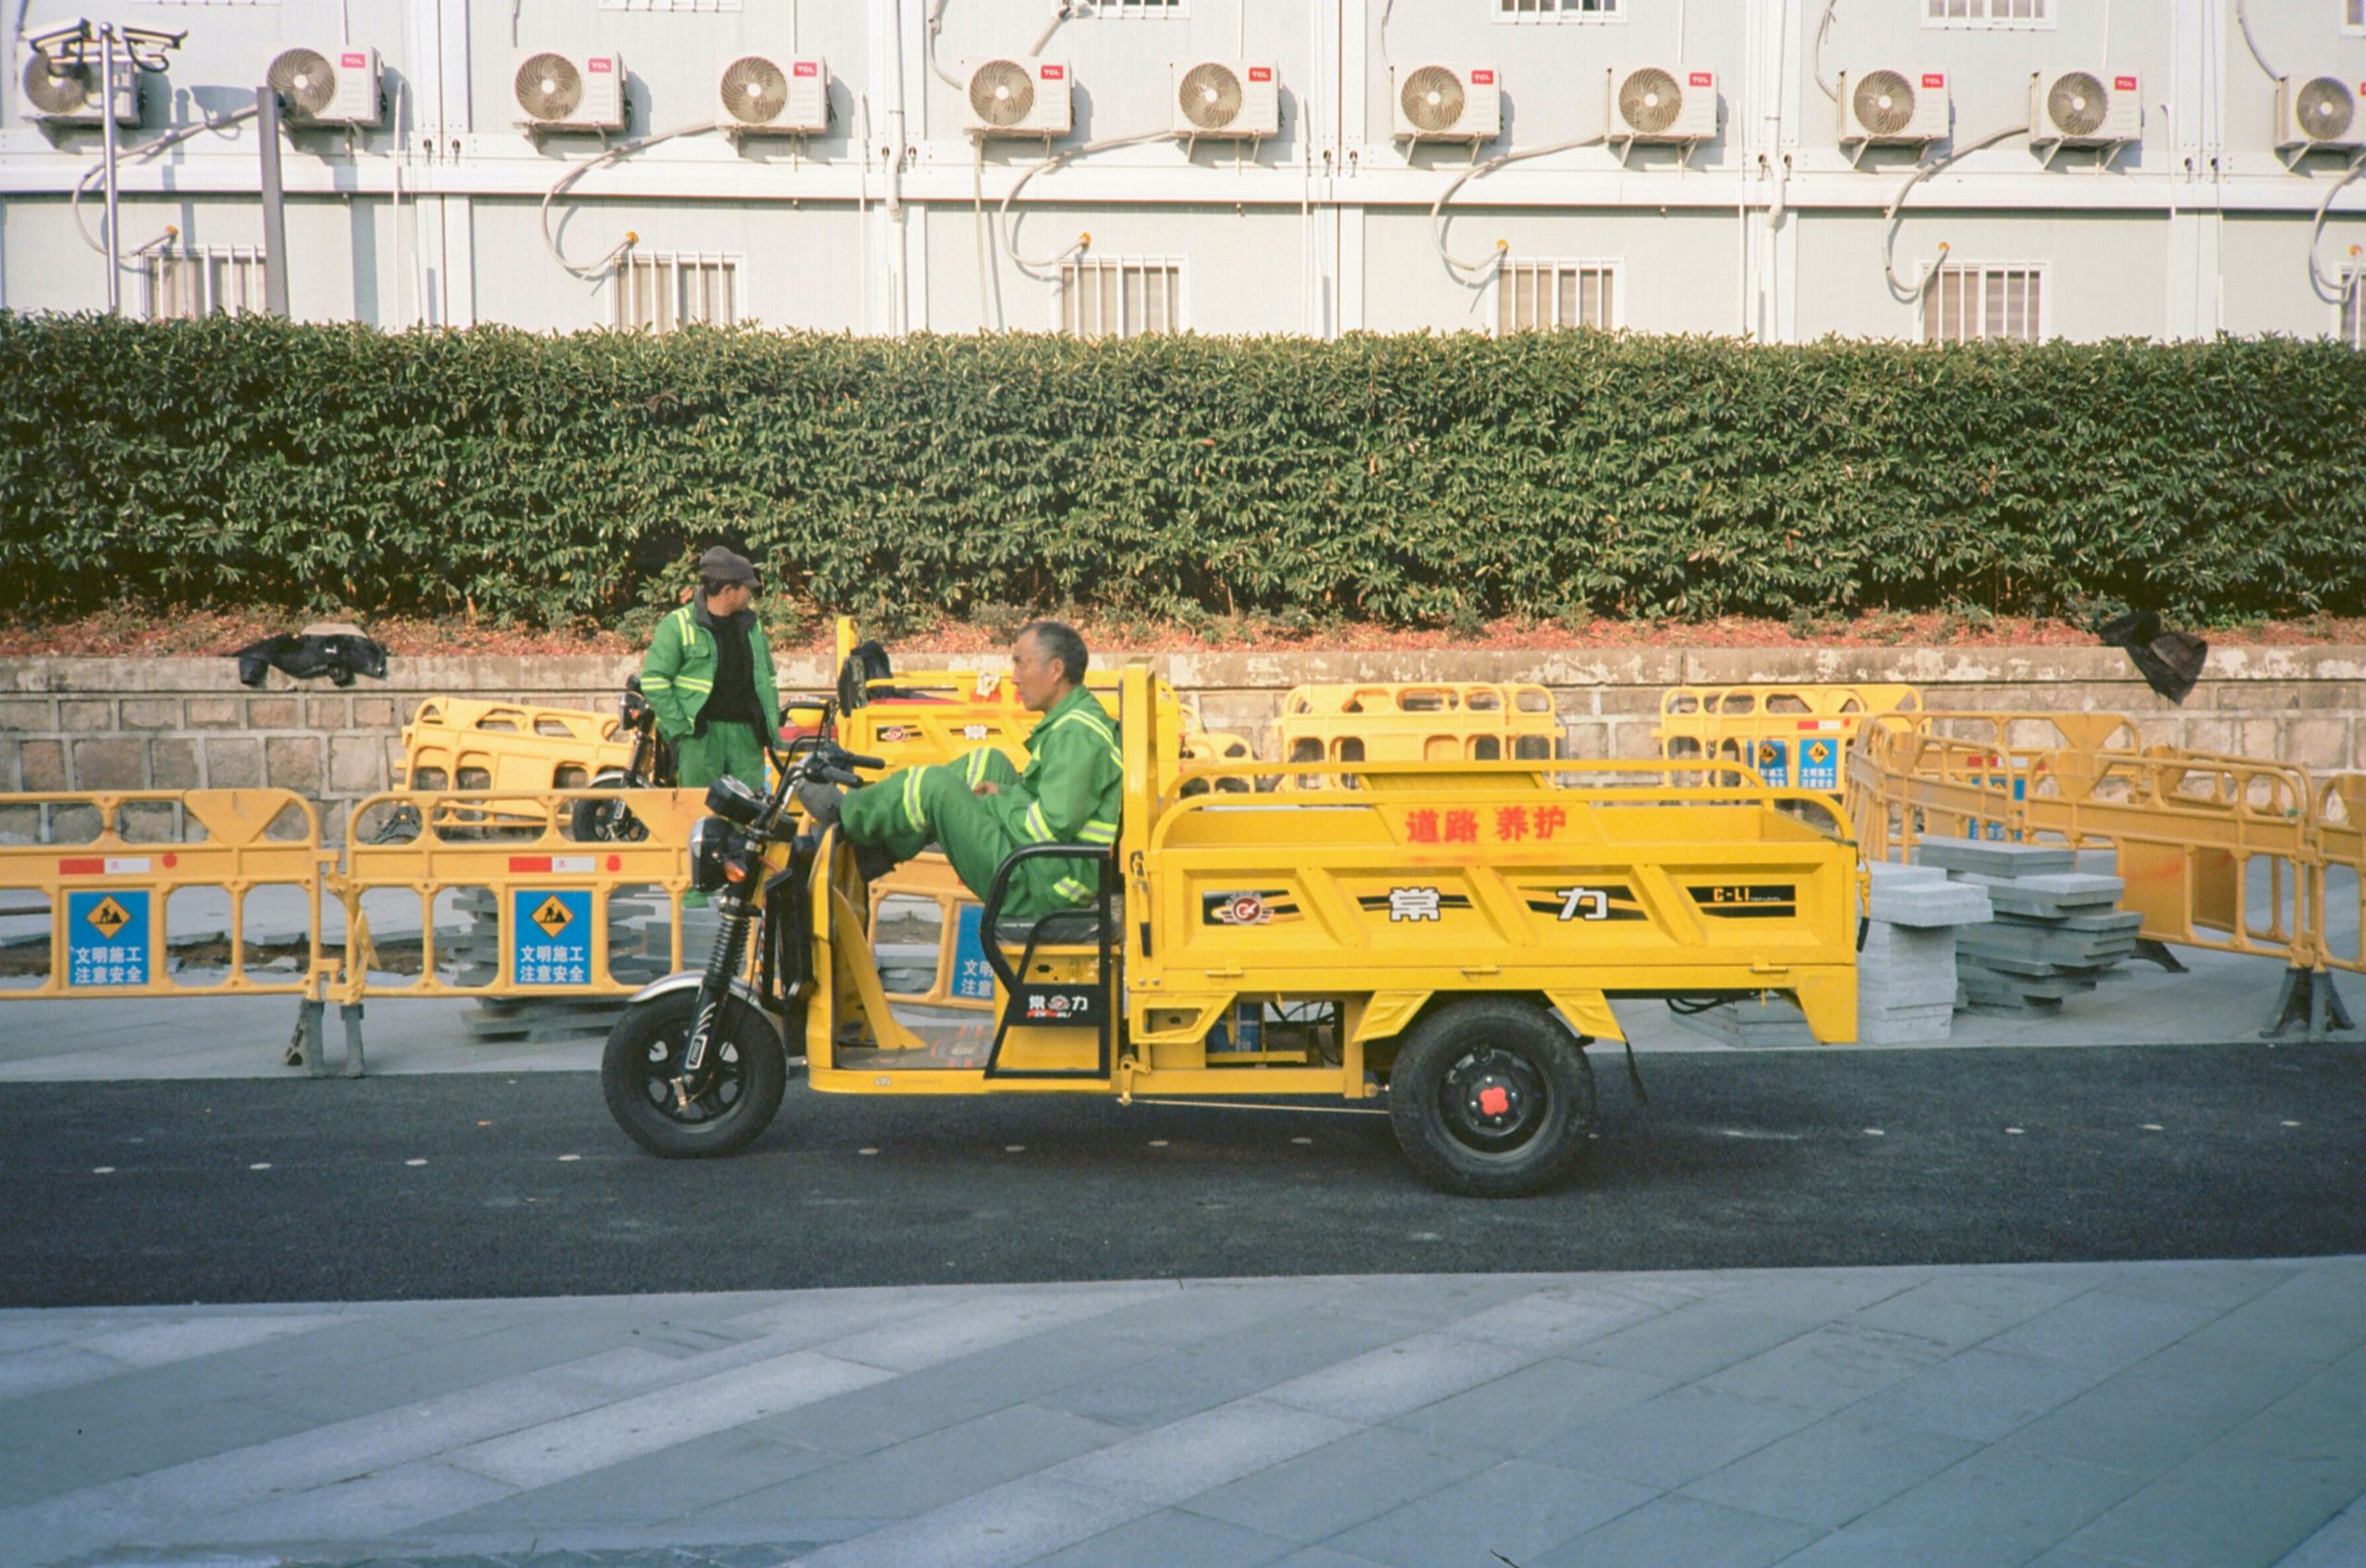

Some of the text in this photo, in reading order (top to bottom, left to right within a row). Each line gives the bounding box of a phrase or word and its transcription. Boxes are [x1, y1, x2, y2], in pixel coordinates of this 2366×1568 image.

[1406, 806, 1567, 843] 道路 养护
[1388, 886, 1608, 922] 常 力
[75, 946, 142, 965] 文明施工
[520, 945, 585, 964] 文明施工
[75, 966, 142, 983] 注意安全
[520, 965, 585, 983] 注意安全
[962, 959, 994, 978] 文明
[961, 978, 993, 997] 注意
